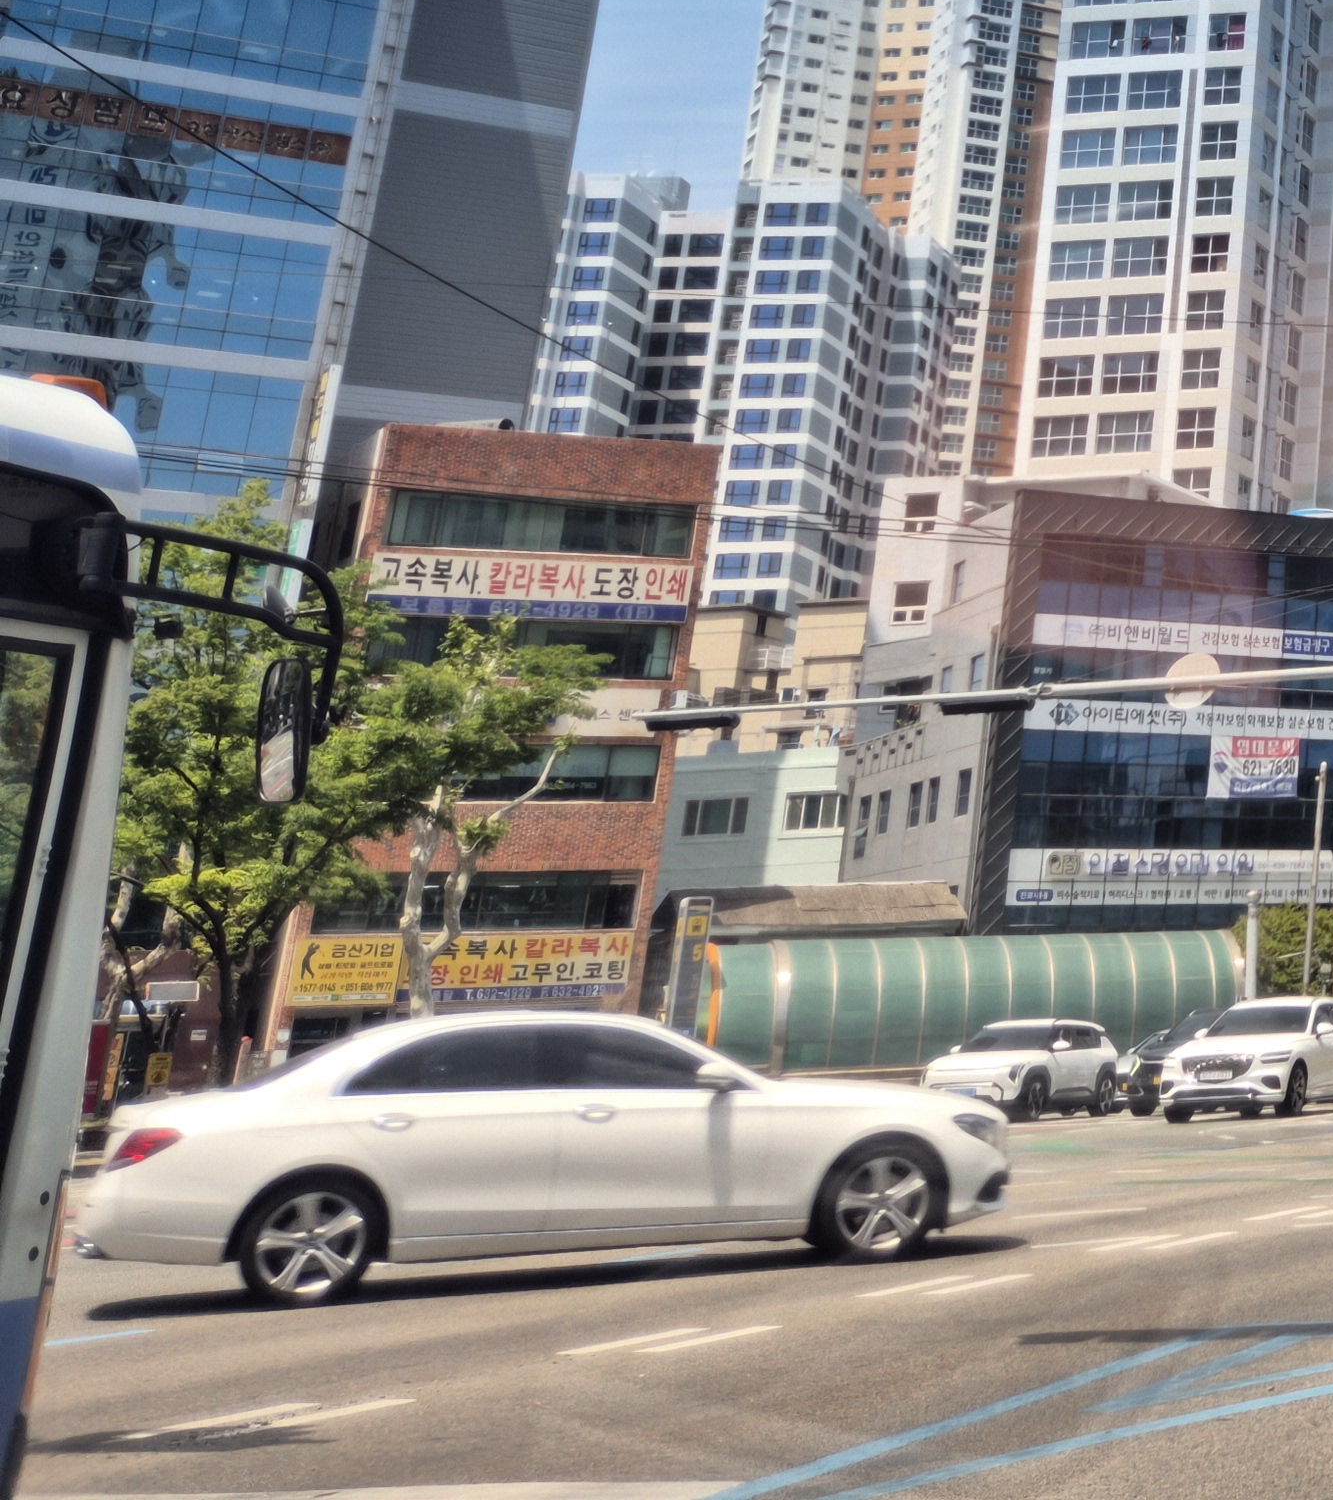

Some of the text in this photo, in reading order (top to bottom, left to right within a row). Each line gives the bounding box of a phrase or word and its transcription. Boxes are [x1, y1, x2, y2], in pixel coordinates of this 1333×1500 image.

[644, 567, 689, 603] 인쇄
[488, 602, 600, 619] 632-4929
[1195, 711, 1245, 728] 자동차보험
[1247, 713, 1285, 729] 화재보험
[1236, 739, 1295, 756] 임대문의
[331, 943, 396, 959] 금산기업
[524, 935, 630, 959] 칼라복사
[691, 943, 704, 962] 5
[458, 962, 503, 985] 인쇄
